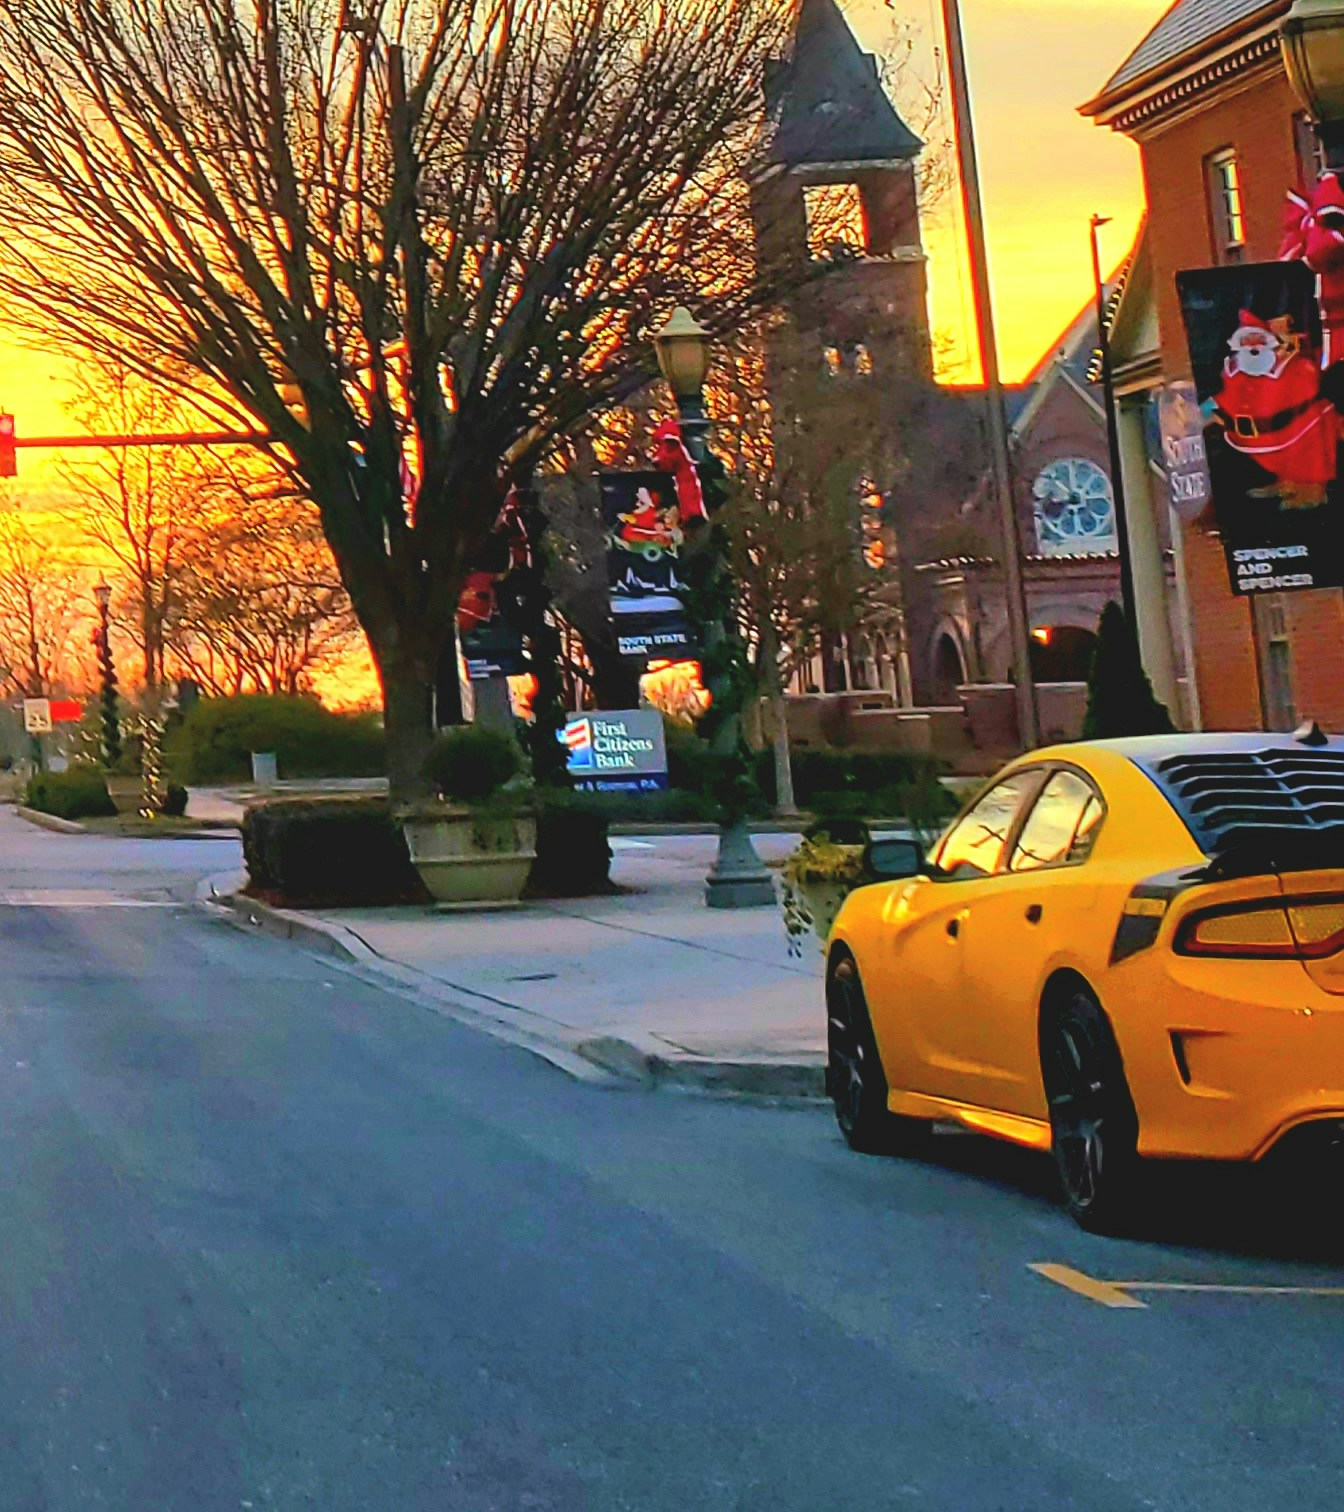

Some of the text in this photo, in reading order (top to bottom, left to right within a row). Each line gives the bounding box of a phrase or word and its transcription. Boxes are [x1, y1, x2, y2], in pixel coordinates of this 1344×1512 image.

[1171, 472, 1207, 502] STATE
[1232, 545, 1309, 562] SPENCER
[1237, 562, 1273, 576] AND
[1238, 573, 1314, 591] SPENCER
[592, 721, 628, 737] First
[593, 736, 654, 753] Citizens
[594, 752, 636, 769] Bank
